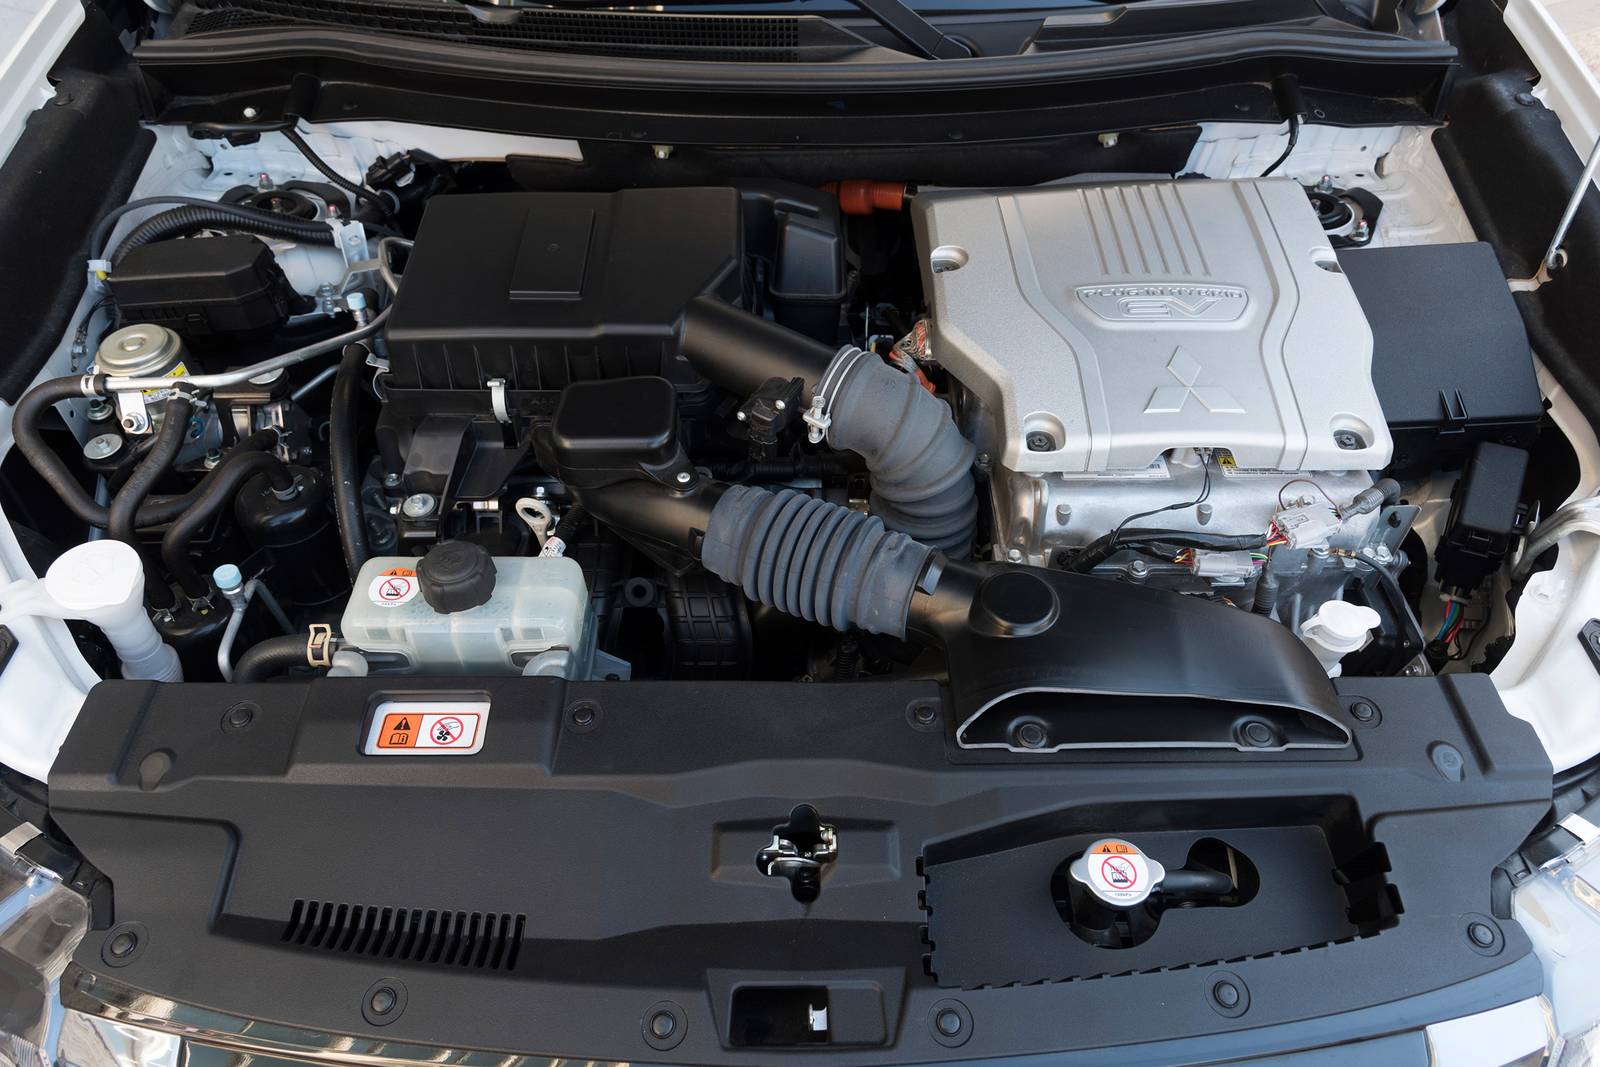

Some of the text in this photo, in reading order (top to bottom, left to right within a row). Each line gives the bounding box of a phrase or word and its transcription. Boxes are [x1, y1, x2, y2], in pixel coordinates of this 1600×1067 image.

[1083, 286, 1243, 298] PLUG-IN HYBRID
[1118, 297, 1222, 318] EV
